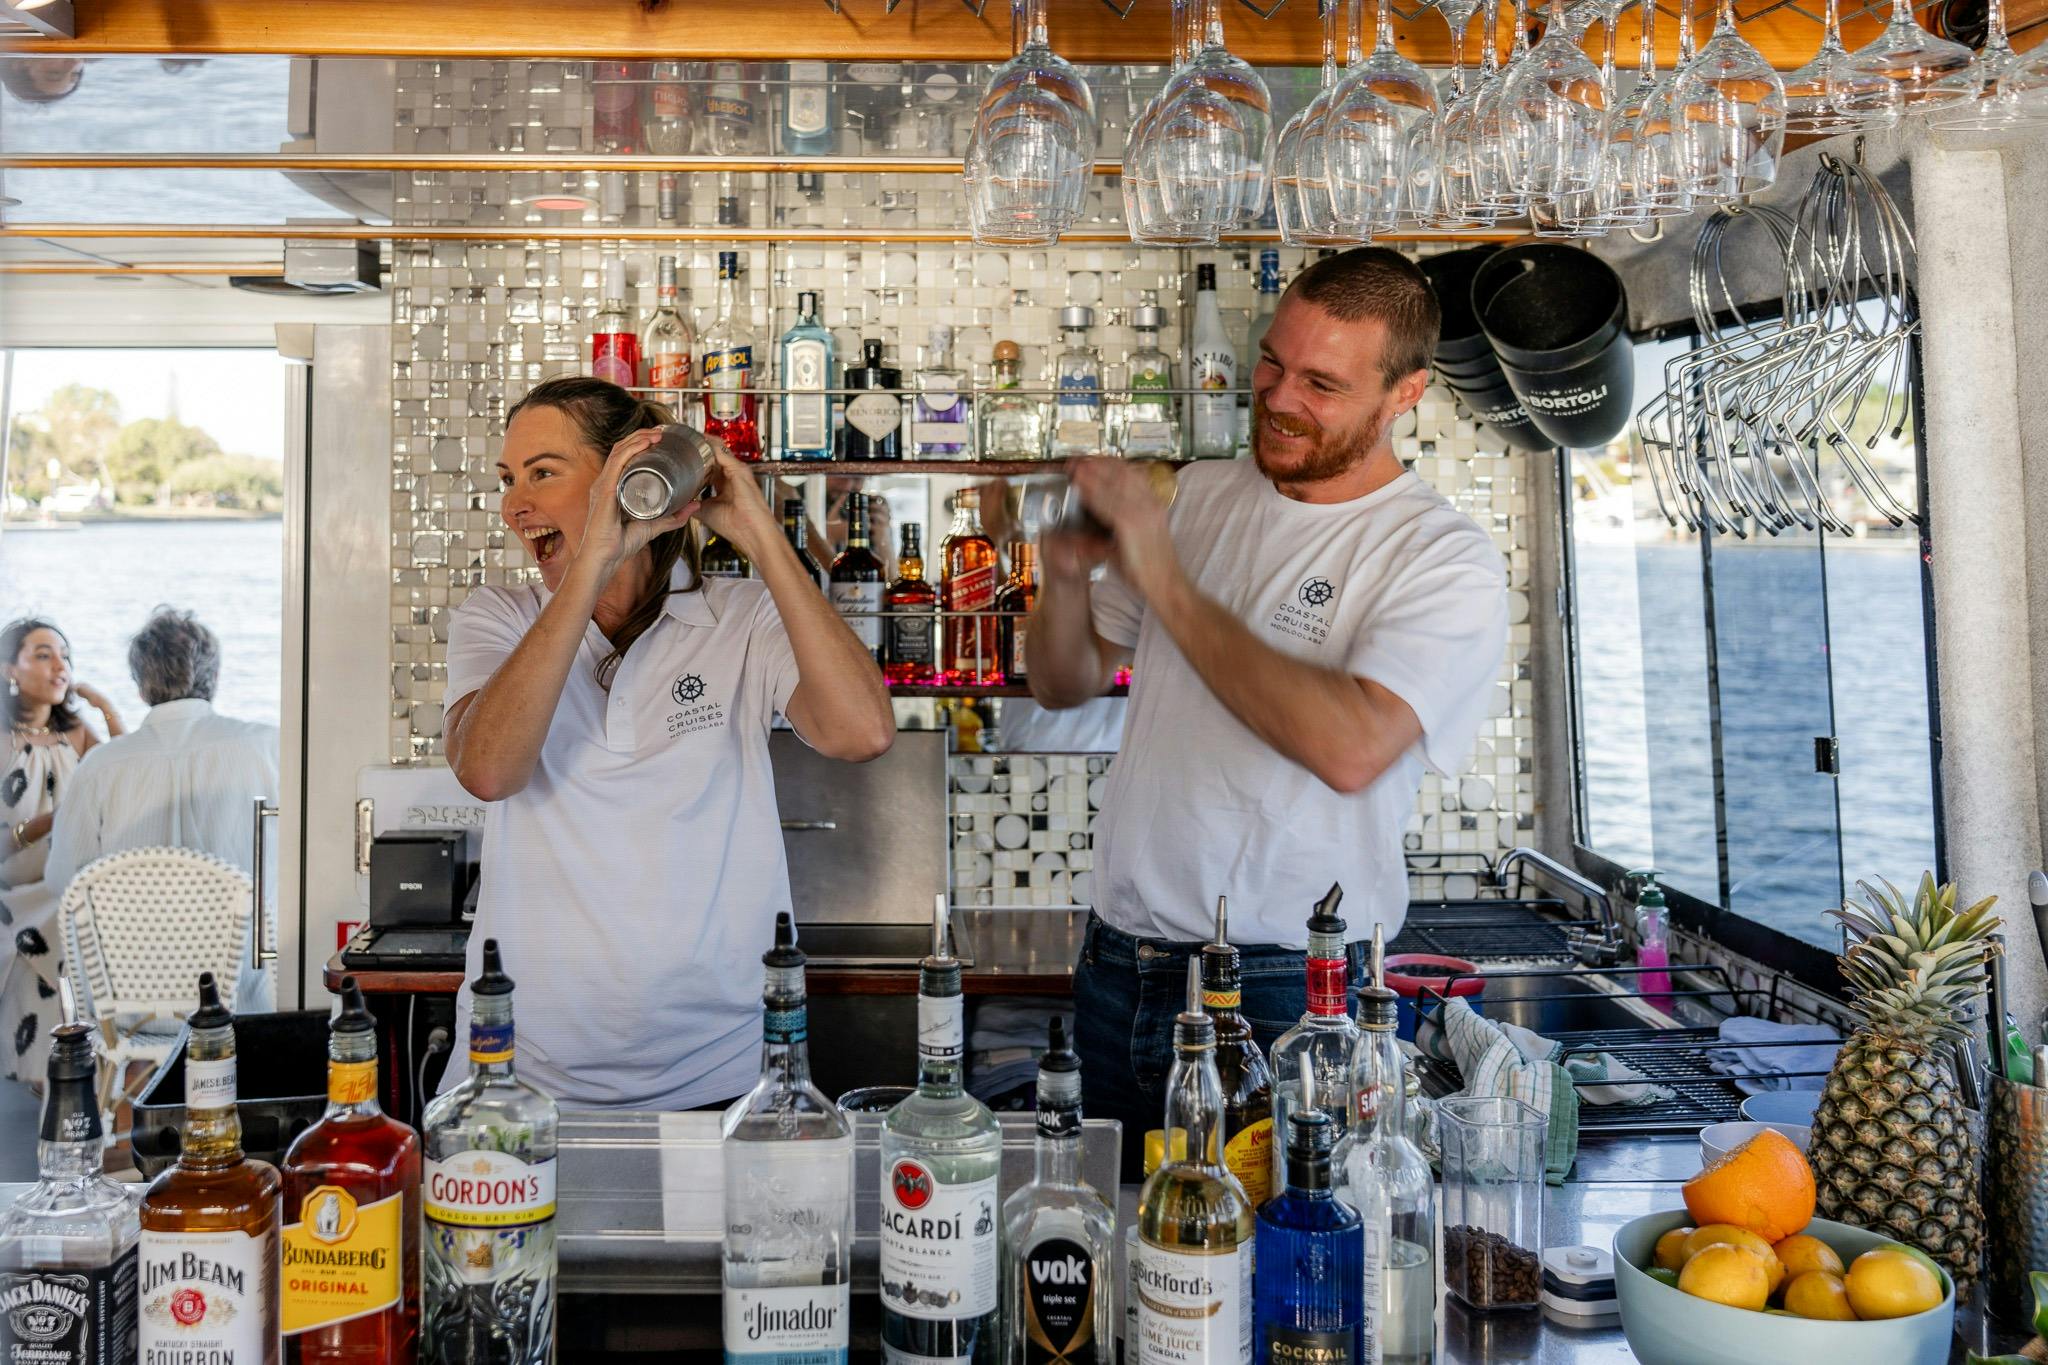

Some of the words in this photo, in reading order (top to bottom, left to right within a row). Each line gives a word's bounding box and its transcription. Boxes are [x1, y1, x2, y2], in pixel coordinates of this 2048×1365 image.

[705, 352, 749, 373] APEROL
[1529, 384, 1608, 409] BORTOLI
[1274, 613, 1327, 638] CRUISES
[1279, 603, 1331, 628] COASTAL
[666, 702, 721, 723] COASTAL
[668, 711, 724, 732] CRUISES
[670, 721, 725, 739] MOOLOOLABA
[400, 882, 423, 891] EPSON
[1037, 1109, 1061, 1127] vok
[432, 1172, 539, 1205] GORDON'S
[282, 1237, 386, 1270] BUNDABERG
[908, 1245, 953, 1256] BLANCA
[142, 1260, 176, 1295] JIM
[181, 1251, 246, 1297] BEAM
[1031, 1254, 1087, 1285] vok
[289, 1279, 369, 1295] ORIGINAL
[0, 1284, 33, 1314] JACK
[31, 1279, 91, 1317] DANIEL'S
[1043, 1294, 1063, 1306] triple
[744, 1307, 754, 1322] el
[748, 1299, 837, 1340] Jimador
[10, 1343, 72, 1361] Tennessee
[155, 1340, 188, 1349] KENTUCKY
[1148, 1343, 1187, 1361] CORDIAL
[1164, 1336, 1203, 1352] JUICE
[1272, 1341, 1348, 1361] COCKTAIL
[146, 1349, 234, 1365] BOURBON
